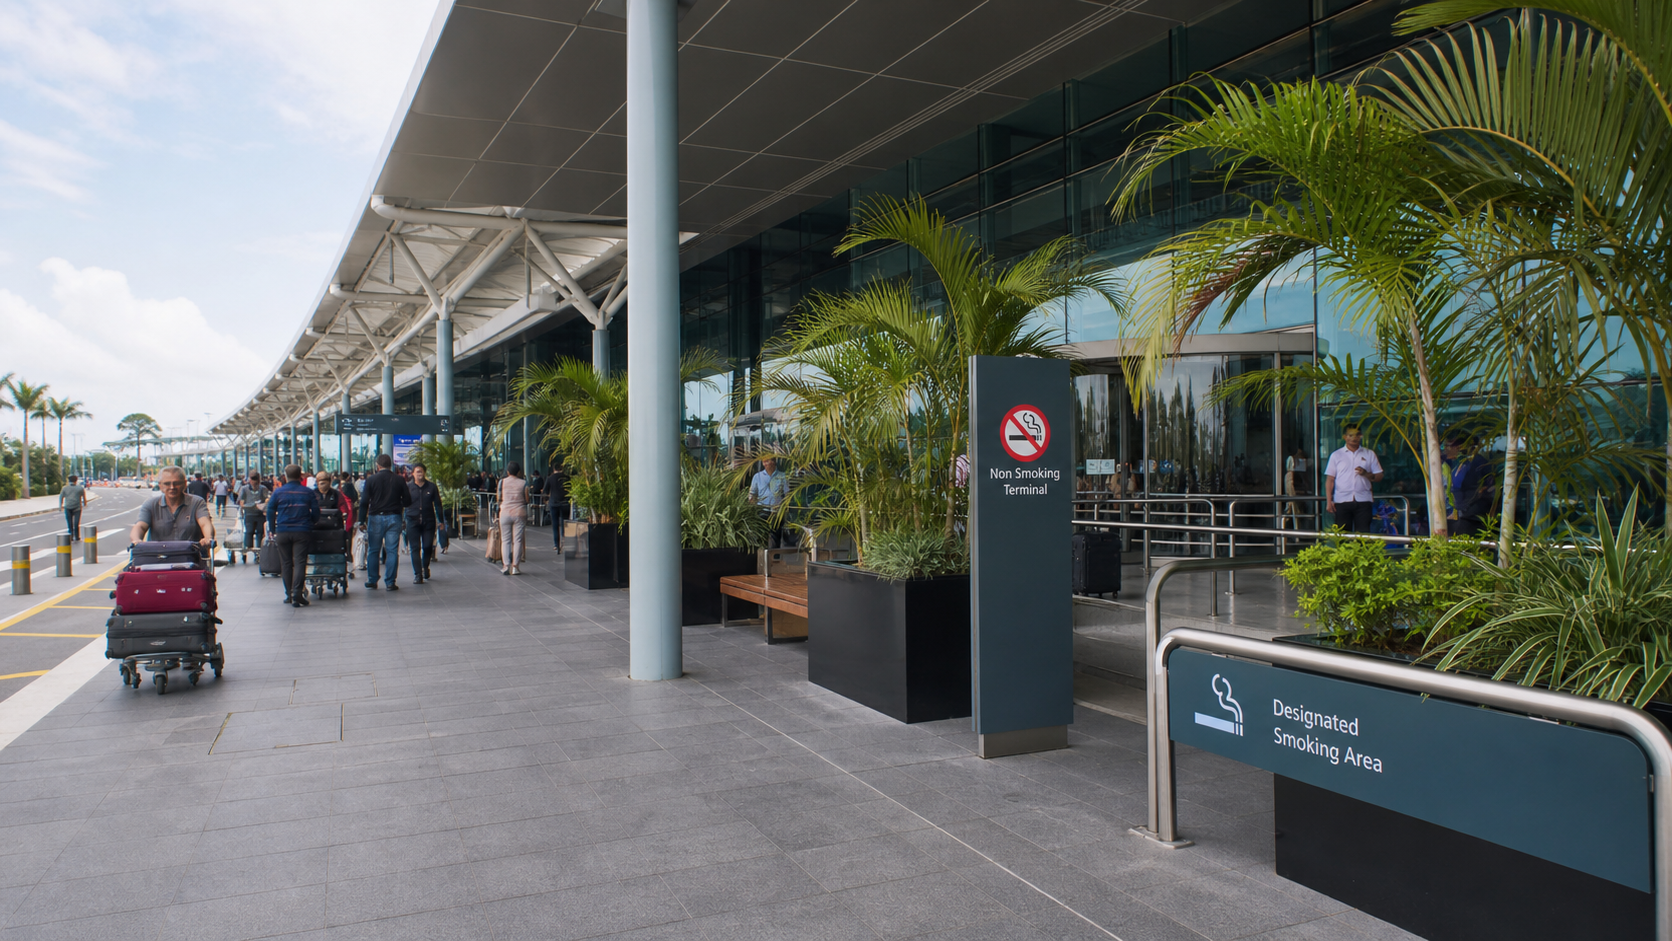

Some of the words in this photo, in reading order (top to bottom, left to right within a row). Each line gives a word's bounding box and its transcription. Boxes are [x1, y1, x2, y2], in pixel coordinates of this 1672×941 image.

[990, 468, 1012, 479] Non
[1015, 467, 1060, 481] Smoking
[1003, 483, 1048, 495] Terminal
[1273, 698, 1359, 737] Designated
[1273, 727, 1340, 765] Smoking
[1344, 746, 1383, 773] Area
